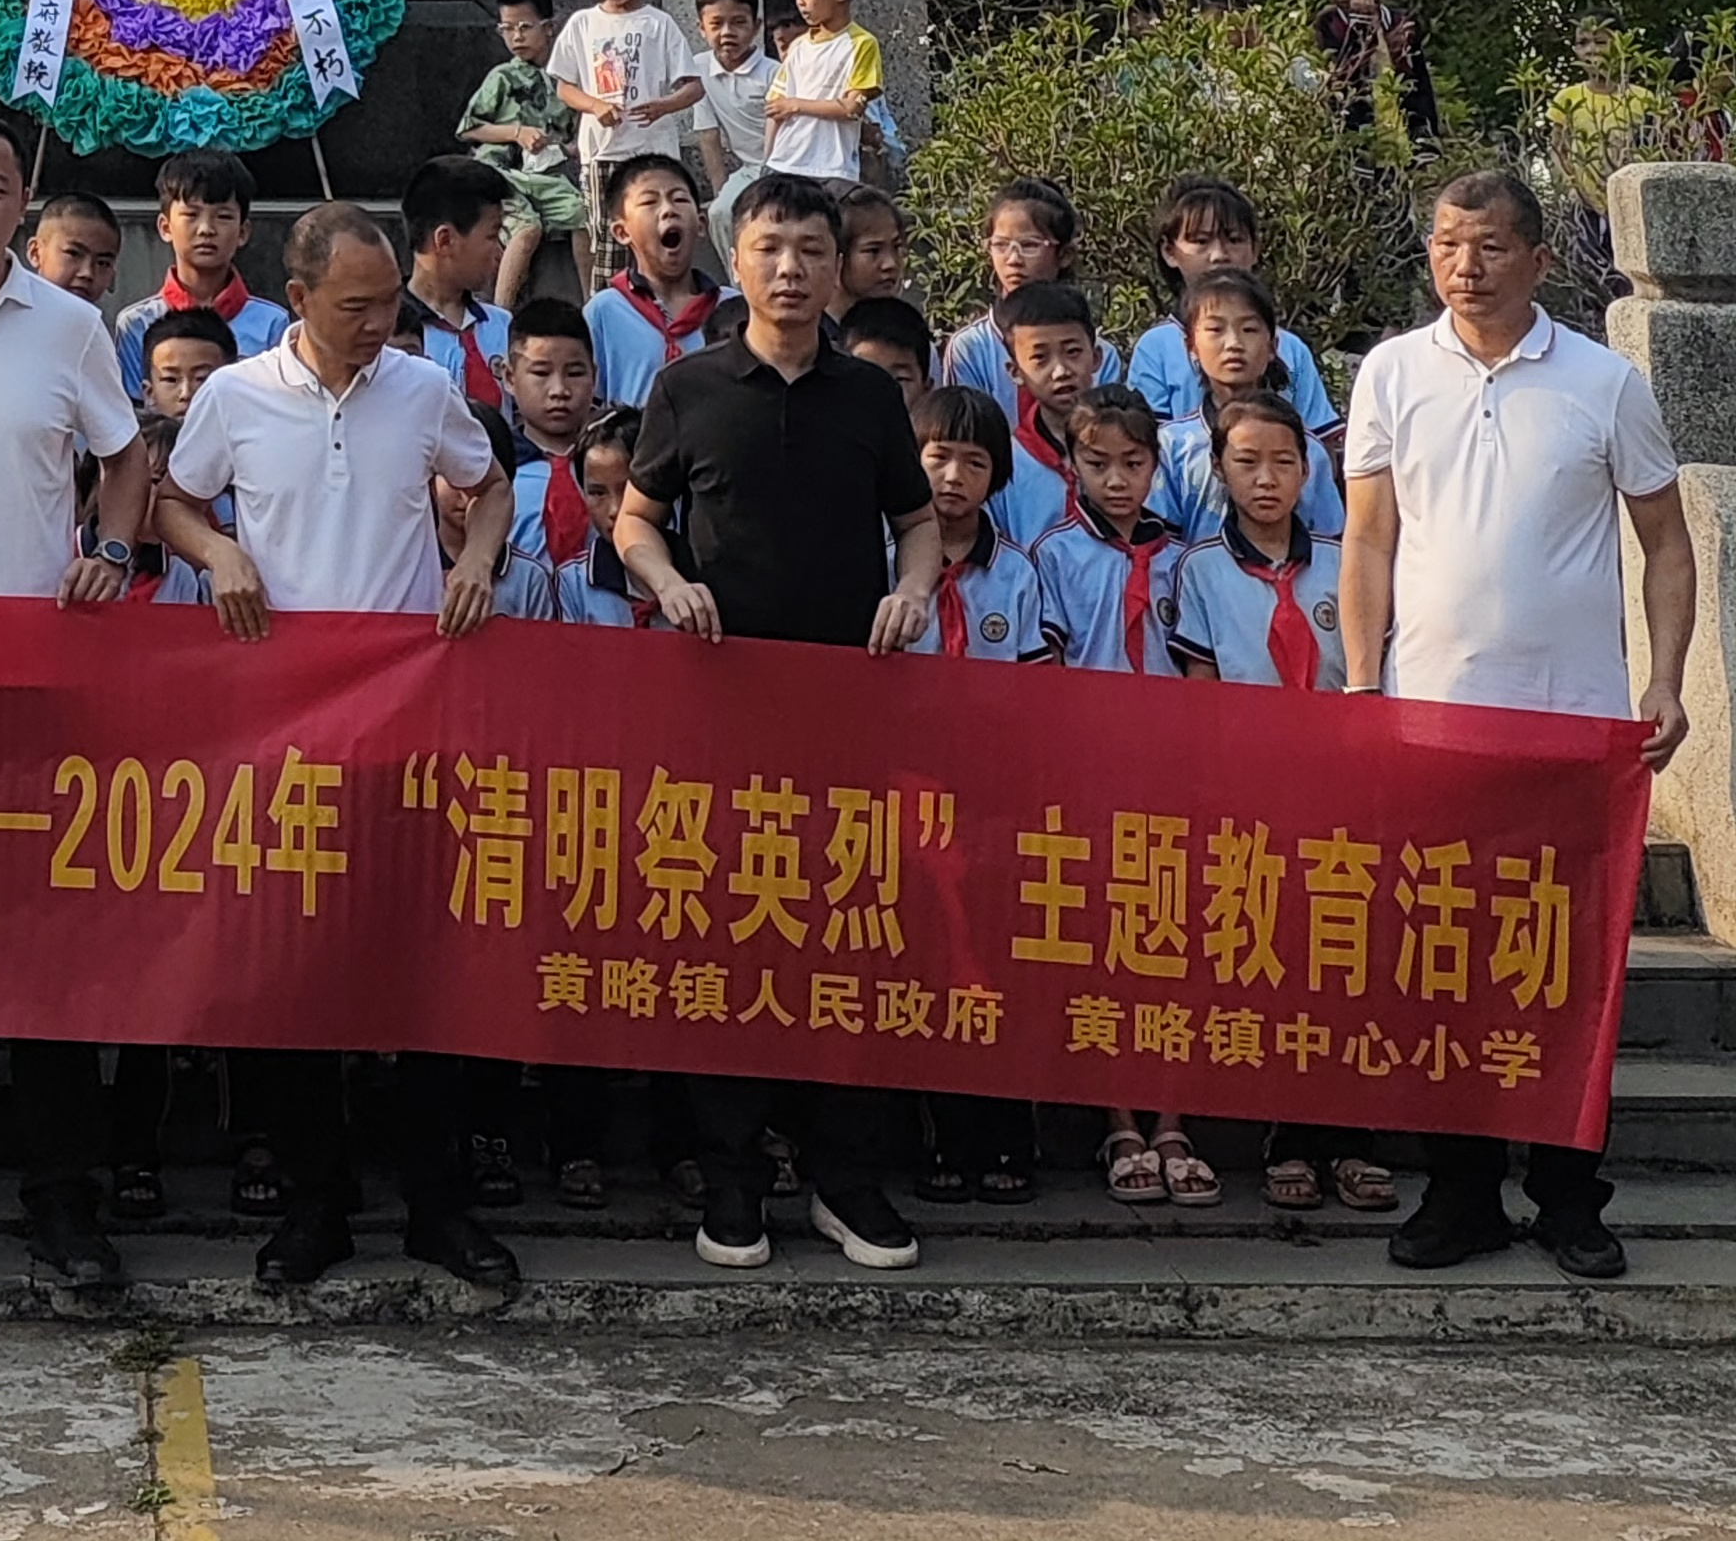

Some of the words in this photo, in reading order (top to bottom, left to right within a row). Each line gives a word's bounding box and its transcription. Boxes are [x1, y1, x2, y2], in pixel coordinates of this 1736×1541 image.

[536, 951, 1004, 1047] 黄略镇人民政府
[1064, 995, 1544, 1089] 黄略镇中心小学
